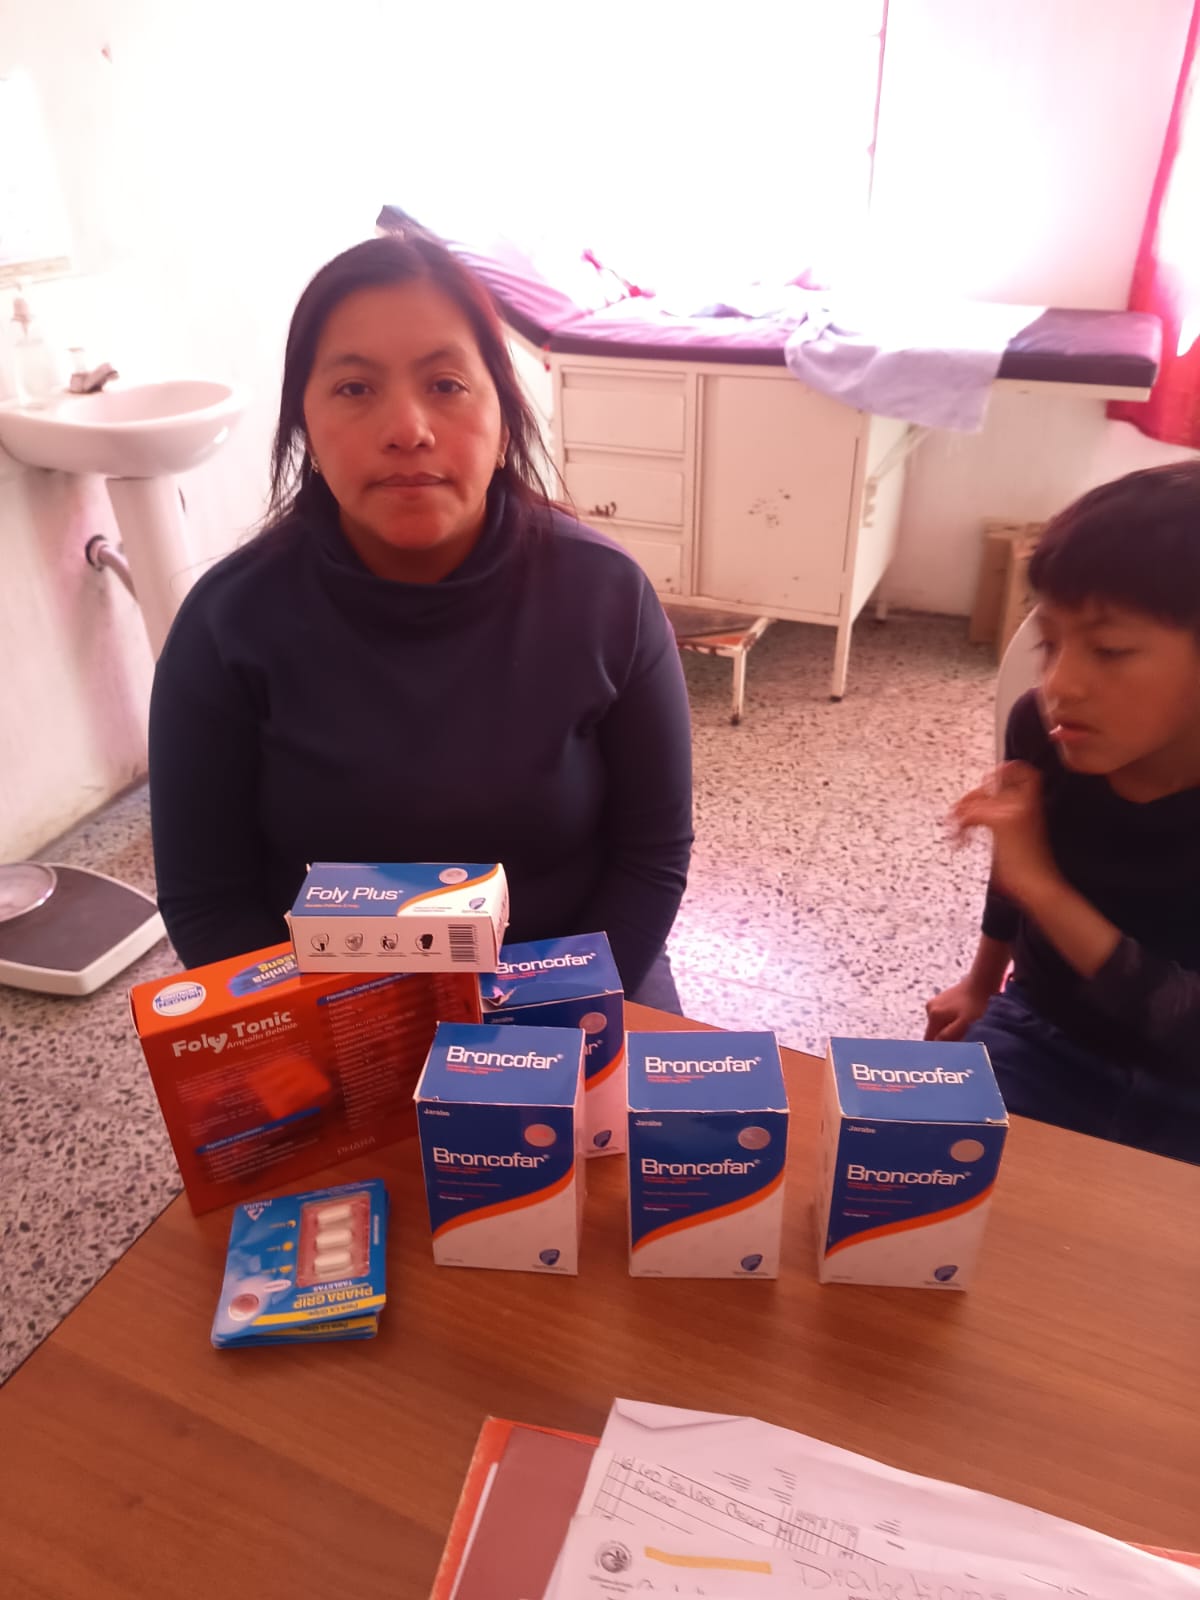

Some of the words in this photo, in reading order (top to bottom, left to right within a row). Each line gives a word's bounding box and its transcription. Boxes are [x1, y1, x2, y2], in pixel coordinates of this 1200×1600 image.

[305, 886, 349, 903] Foly
[352, 886, 400, 901] Plus
[172, 1031, 229, 1058] Foly
[232, 1010, 292, 1039] Tonic
[292, 1292, 326, 1310] GRIP
[328, 1285, 374, 1303] PHARA
